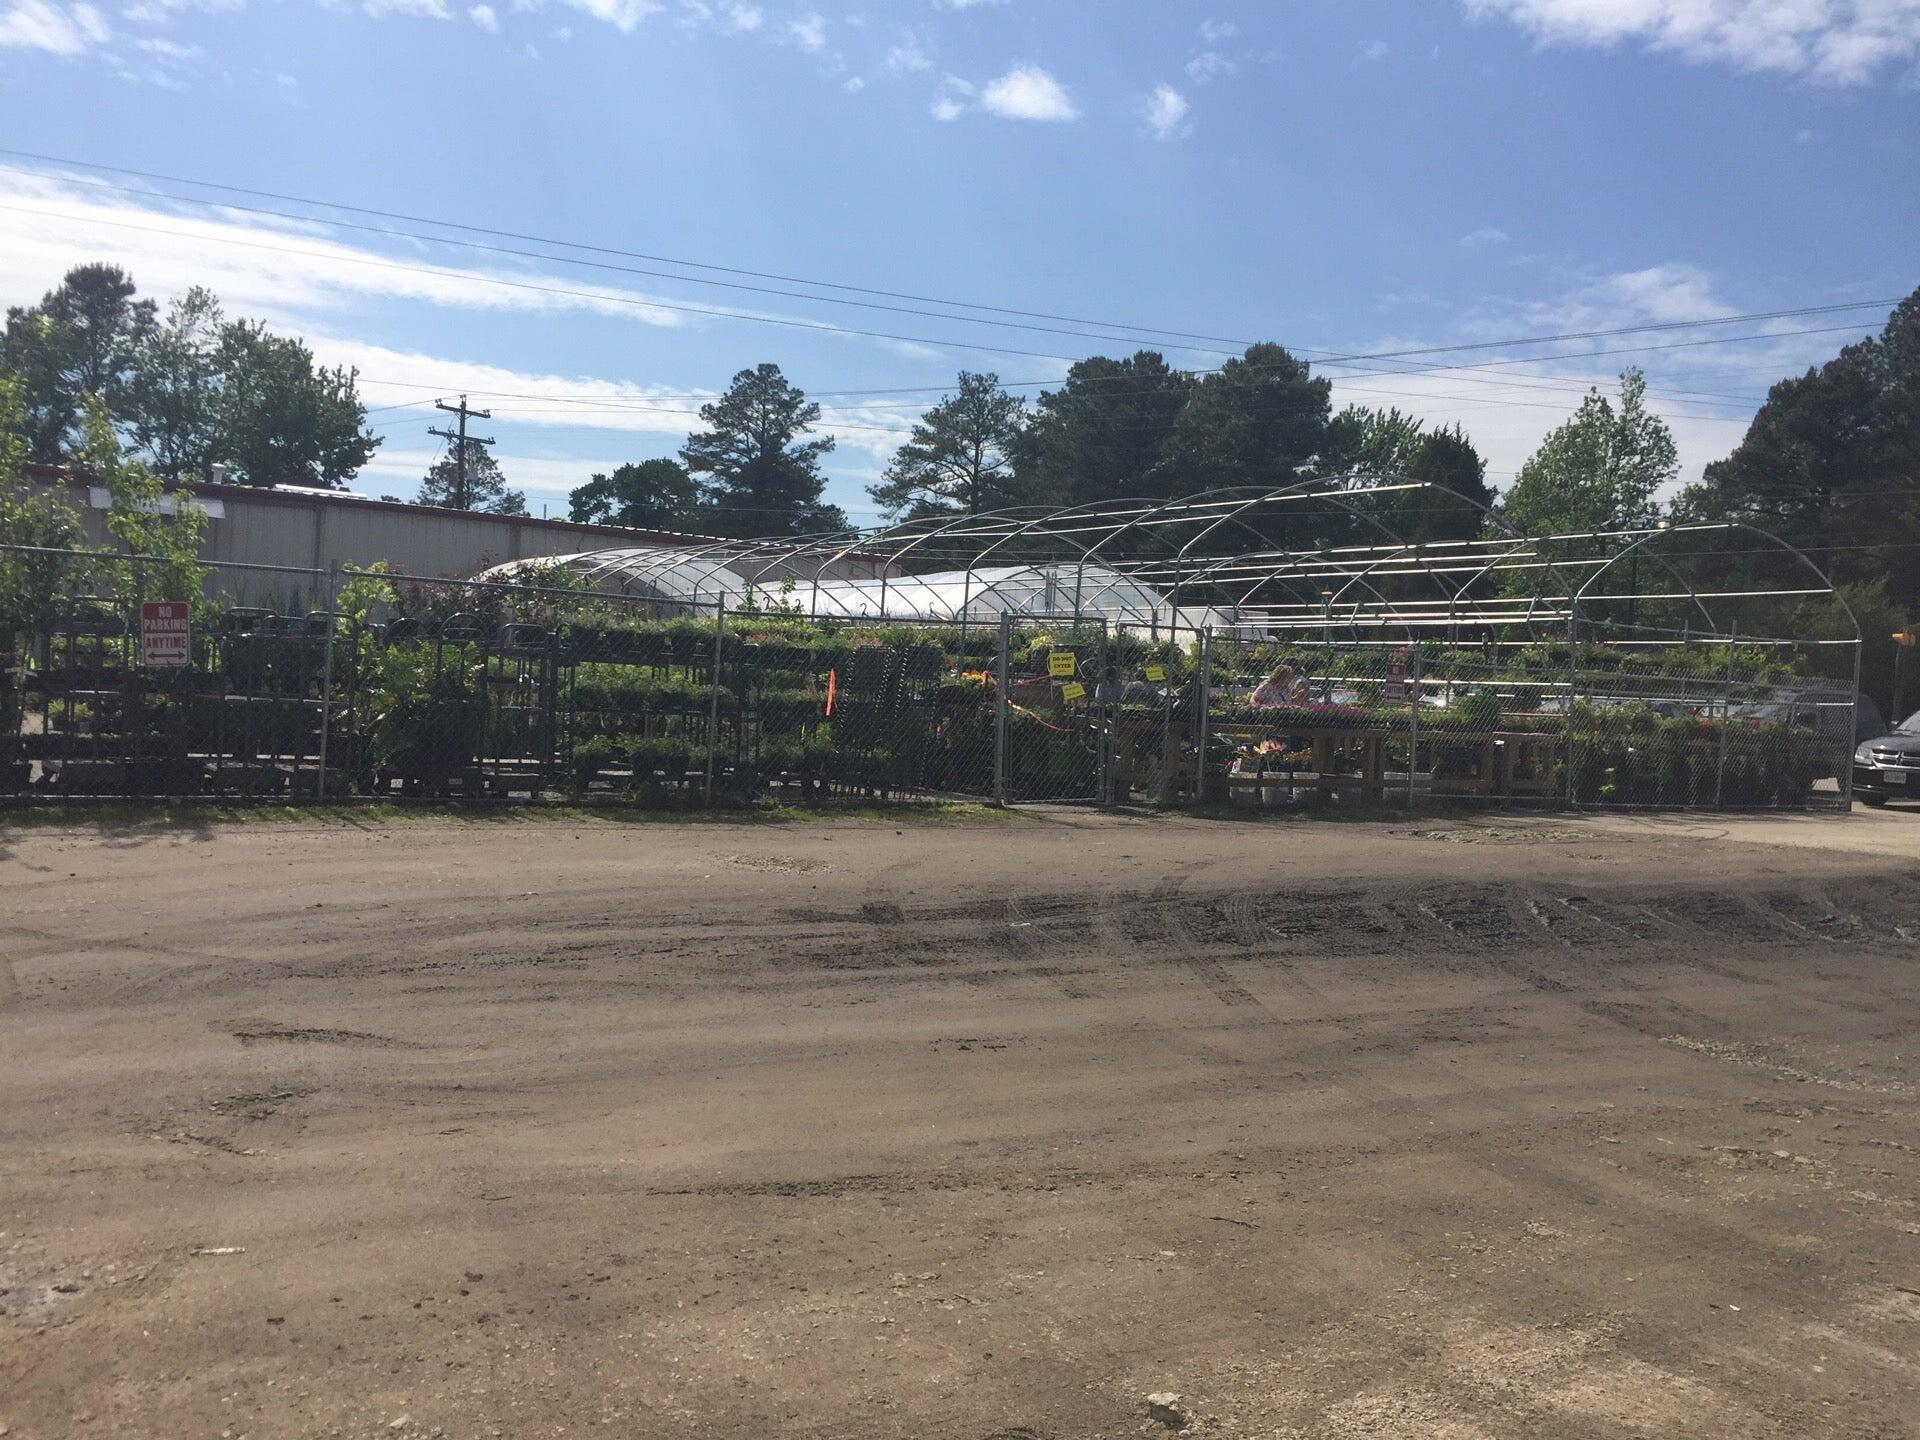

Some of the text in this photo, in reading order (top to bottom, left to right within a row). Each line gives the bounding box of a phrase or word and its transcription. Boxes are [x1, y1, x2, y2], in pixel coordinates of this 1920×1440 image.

[158, 606, 172, 617] NO
[144, 618, 187, 630] PARKING
[145, 637, 187, 648] ANYTIME
